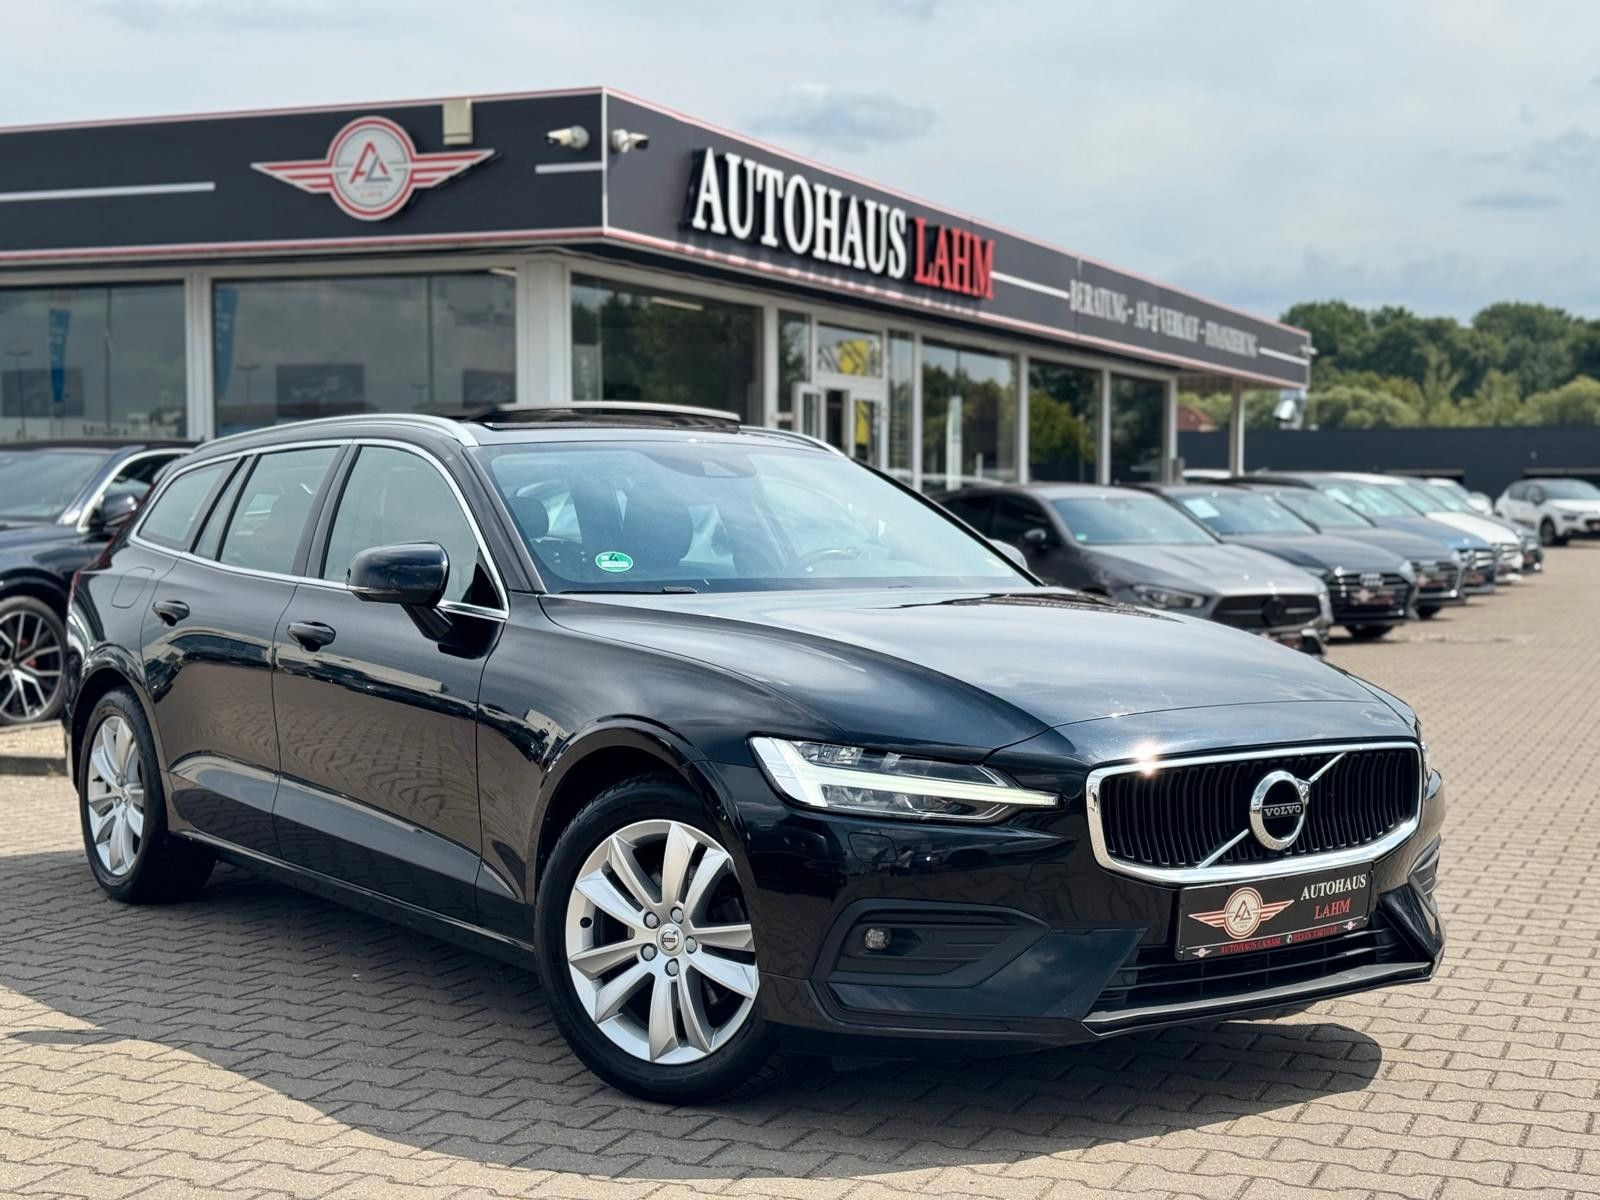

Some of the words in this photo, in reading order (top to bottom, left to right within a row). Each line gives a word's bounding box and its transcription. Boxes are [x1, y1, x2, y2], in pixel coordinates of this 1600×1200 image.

[691, 146, 907, 279] AUTOHAUS
[913, 215, 996, 299] LAHM
[1263, 804, 1302, 817] VOLVO
[1300, 873, 1367, 901] AUTOHAUS
[1313, 898, 1351, 920] LAHM
